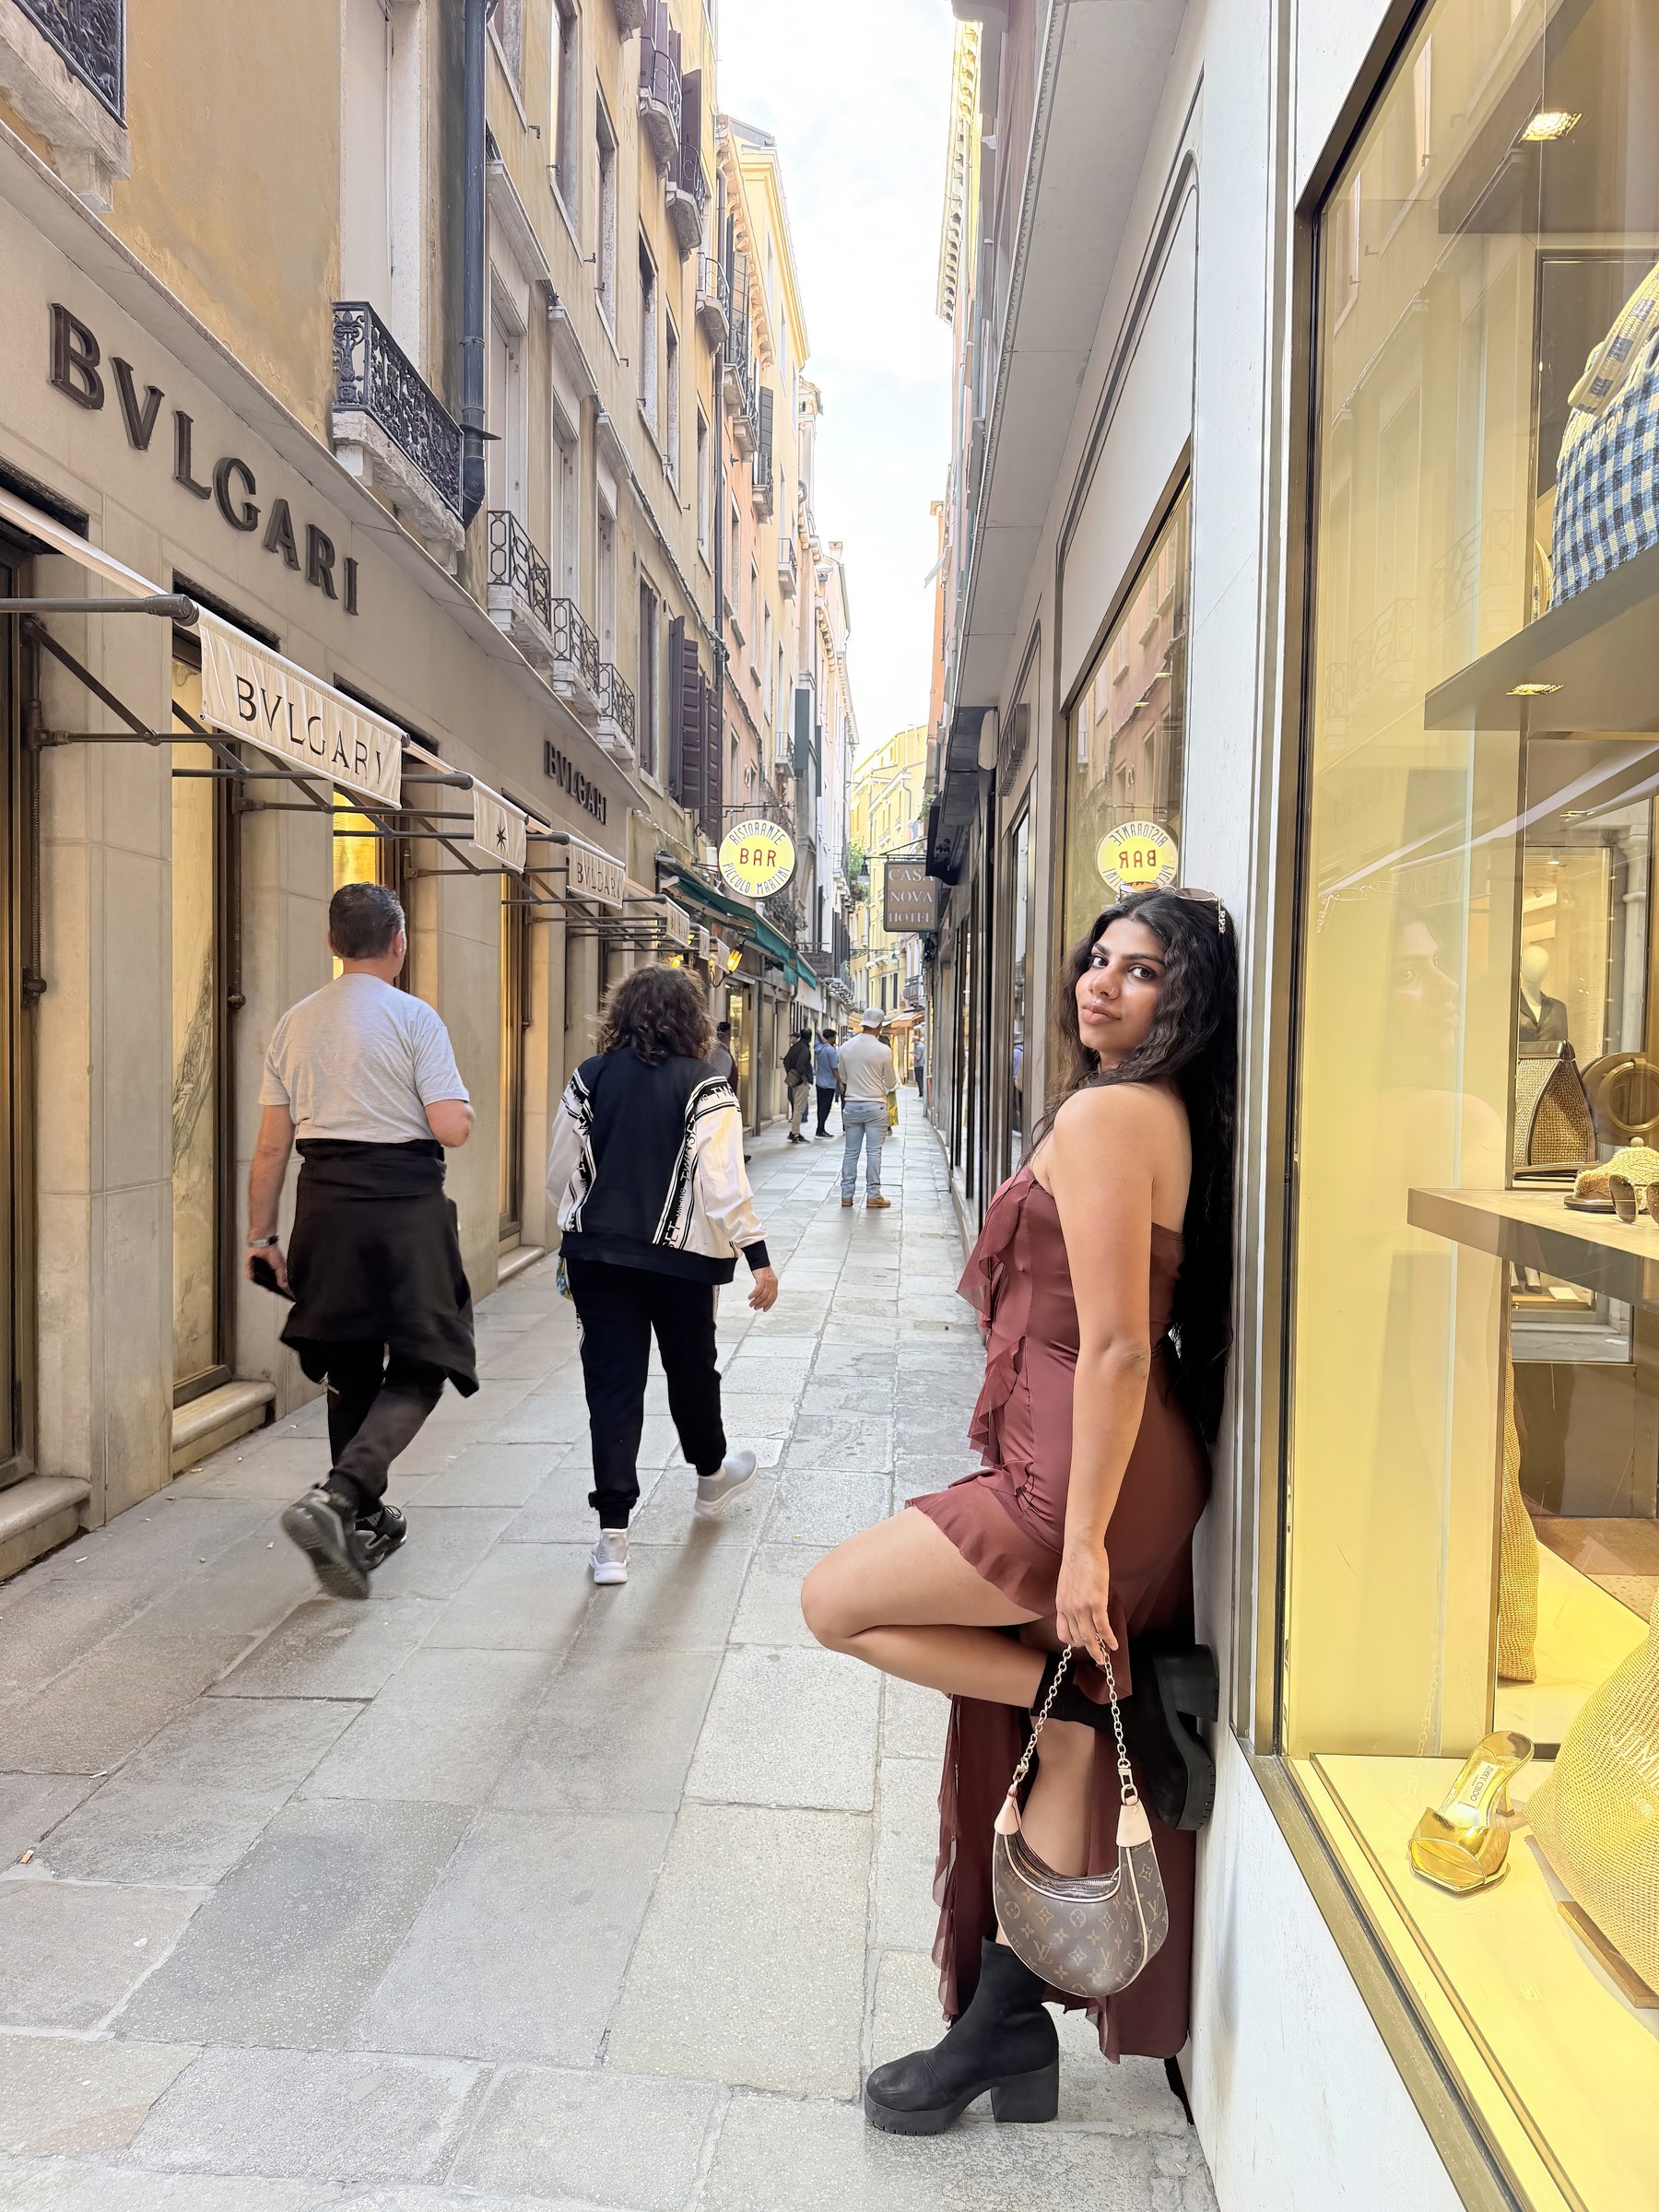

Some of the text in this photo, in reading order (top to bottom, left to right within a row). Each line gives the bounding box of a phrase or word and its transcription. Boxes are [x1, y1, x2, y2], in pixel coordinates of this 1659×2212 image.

[1577, 406, 1624, 463] LONDON
[49, 302, 359, 617] BVLGARI
[235, 674, 382, 784] BVLGARI
[544, 740, 607, 826] BVLGARI
[728, 819, 786, 846] RISTORANTE
[739, 847, 777, 867] BAR
[723, 862, 791, 894] PICCOLO MARTINI
[890, 890, 934, 902] NOVA
[888, 912, 934, 923] HOTEL
[1470, 1782, 1484, 1802] CHOO
